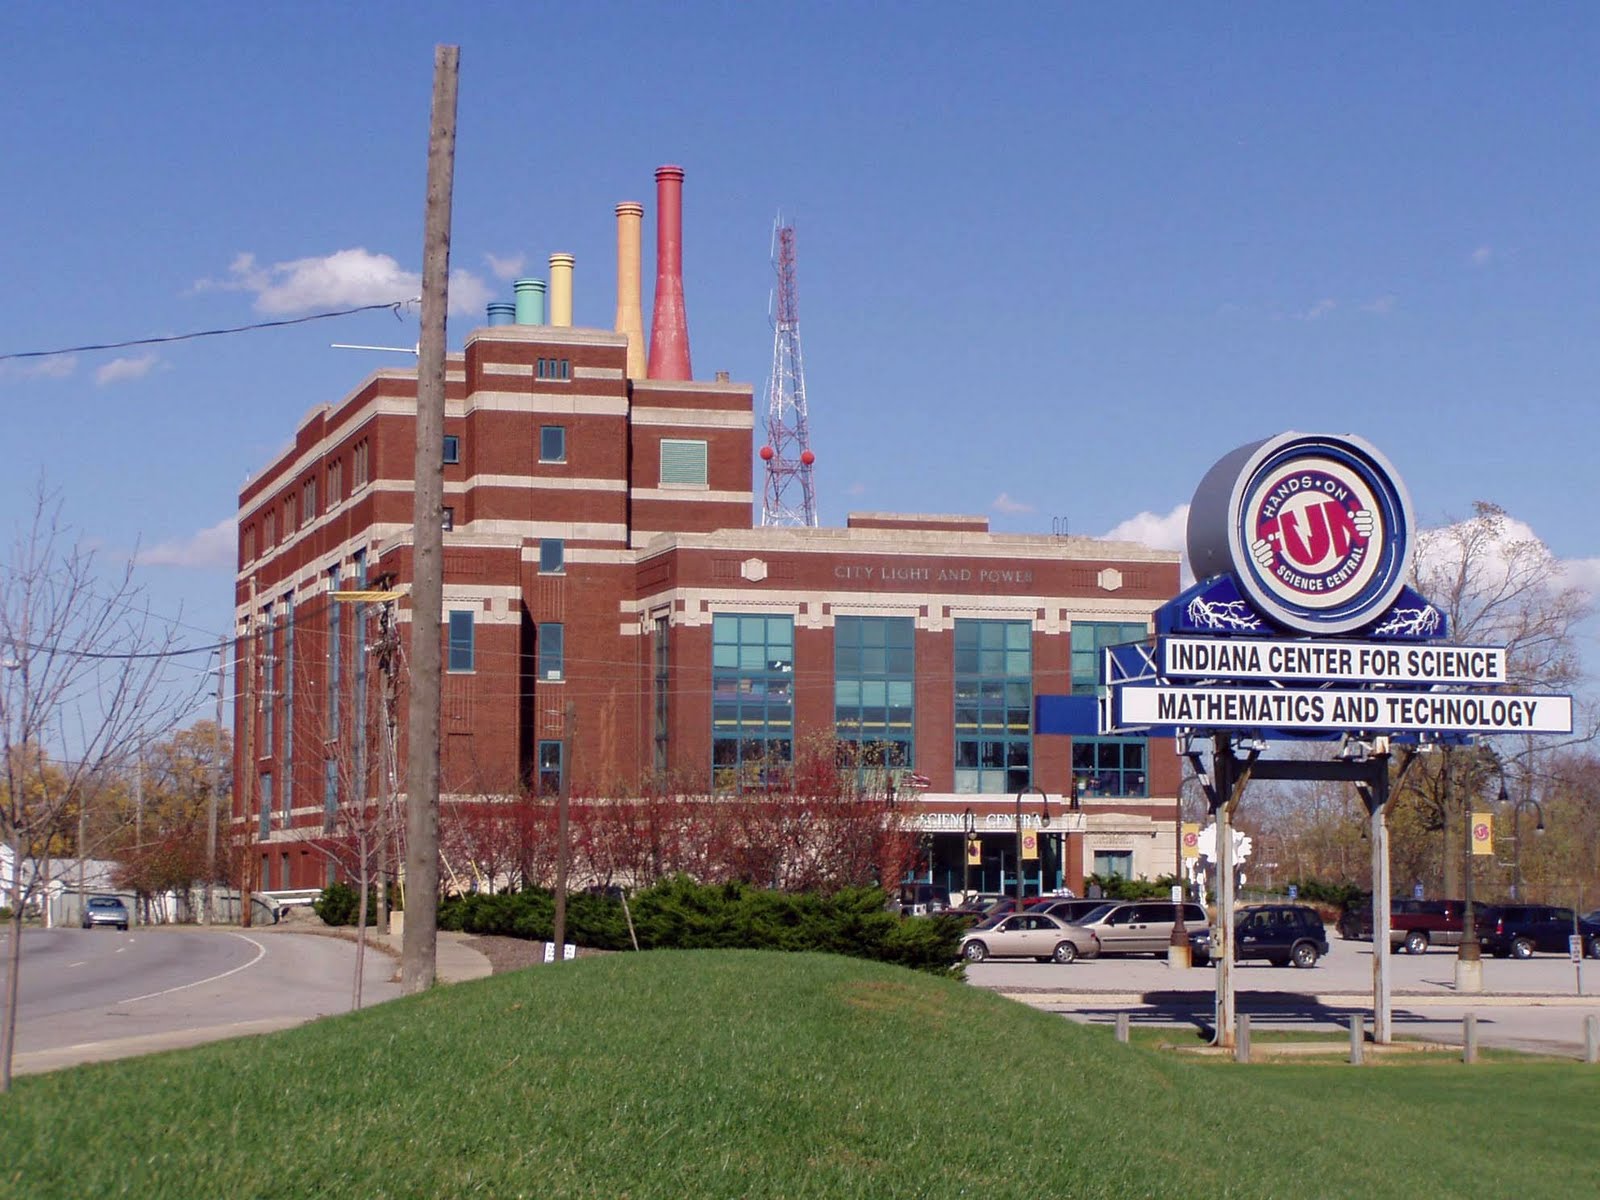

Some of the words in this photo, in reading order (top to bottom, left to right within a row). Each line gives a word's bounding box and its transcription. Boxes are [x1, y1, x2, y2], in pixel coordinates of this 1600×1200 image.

[1263, 476, 1312, 518] HANDS
[834, 565, 873, 579] CITY
[881, 567, 930, 580] LIGHT
[938, 568, 971, 582] AND
[980, 569, 1033, 583] POWER
[1277, 565, 1323, 590] SCIENCE
[1326, 547, 1364, 588] CENTRAL
[1171, 644, 1262, 672] INDIANA
[1268, 646, 1352, 675] CENTER
[1359, 649, 1400, 676] FOR
[1407, 650, 1497, 678] SCIENCE
[1158, 693, 1325, 722] MATHEMATICS
[1331, 696, 1378, 723] AND
[1386, 698, 1538, 727] TECHNOLOGY
